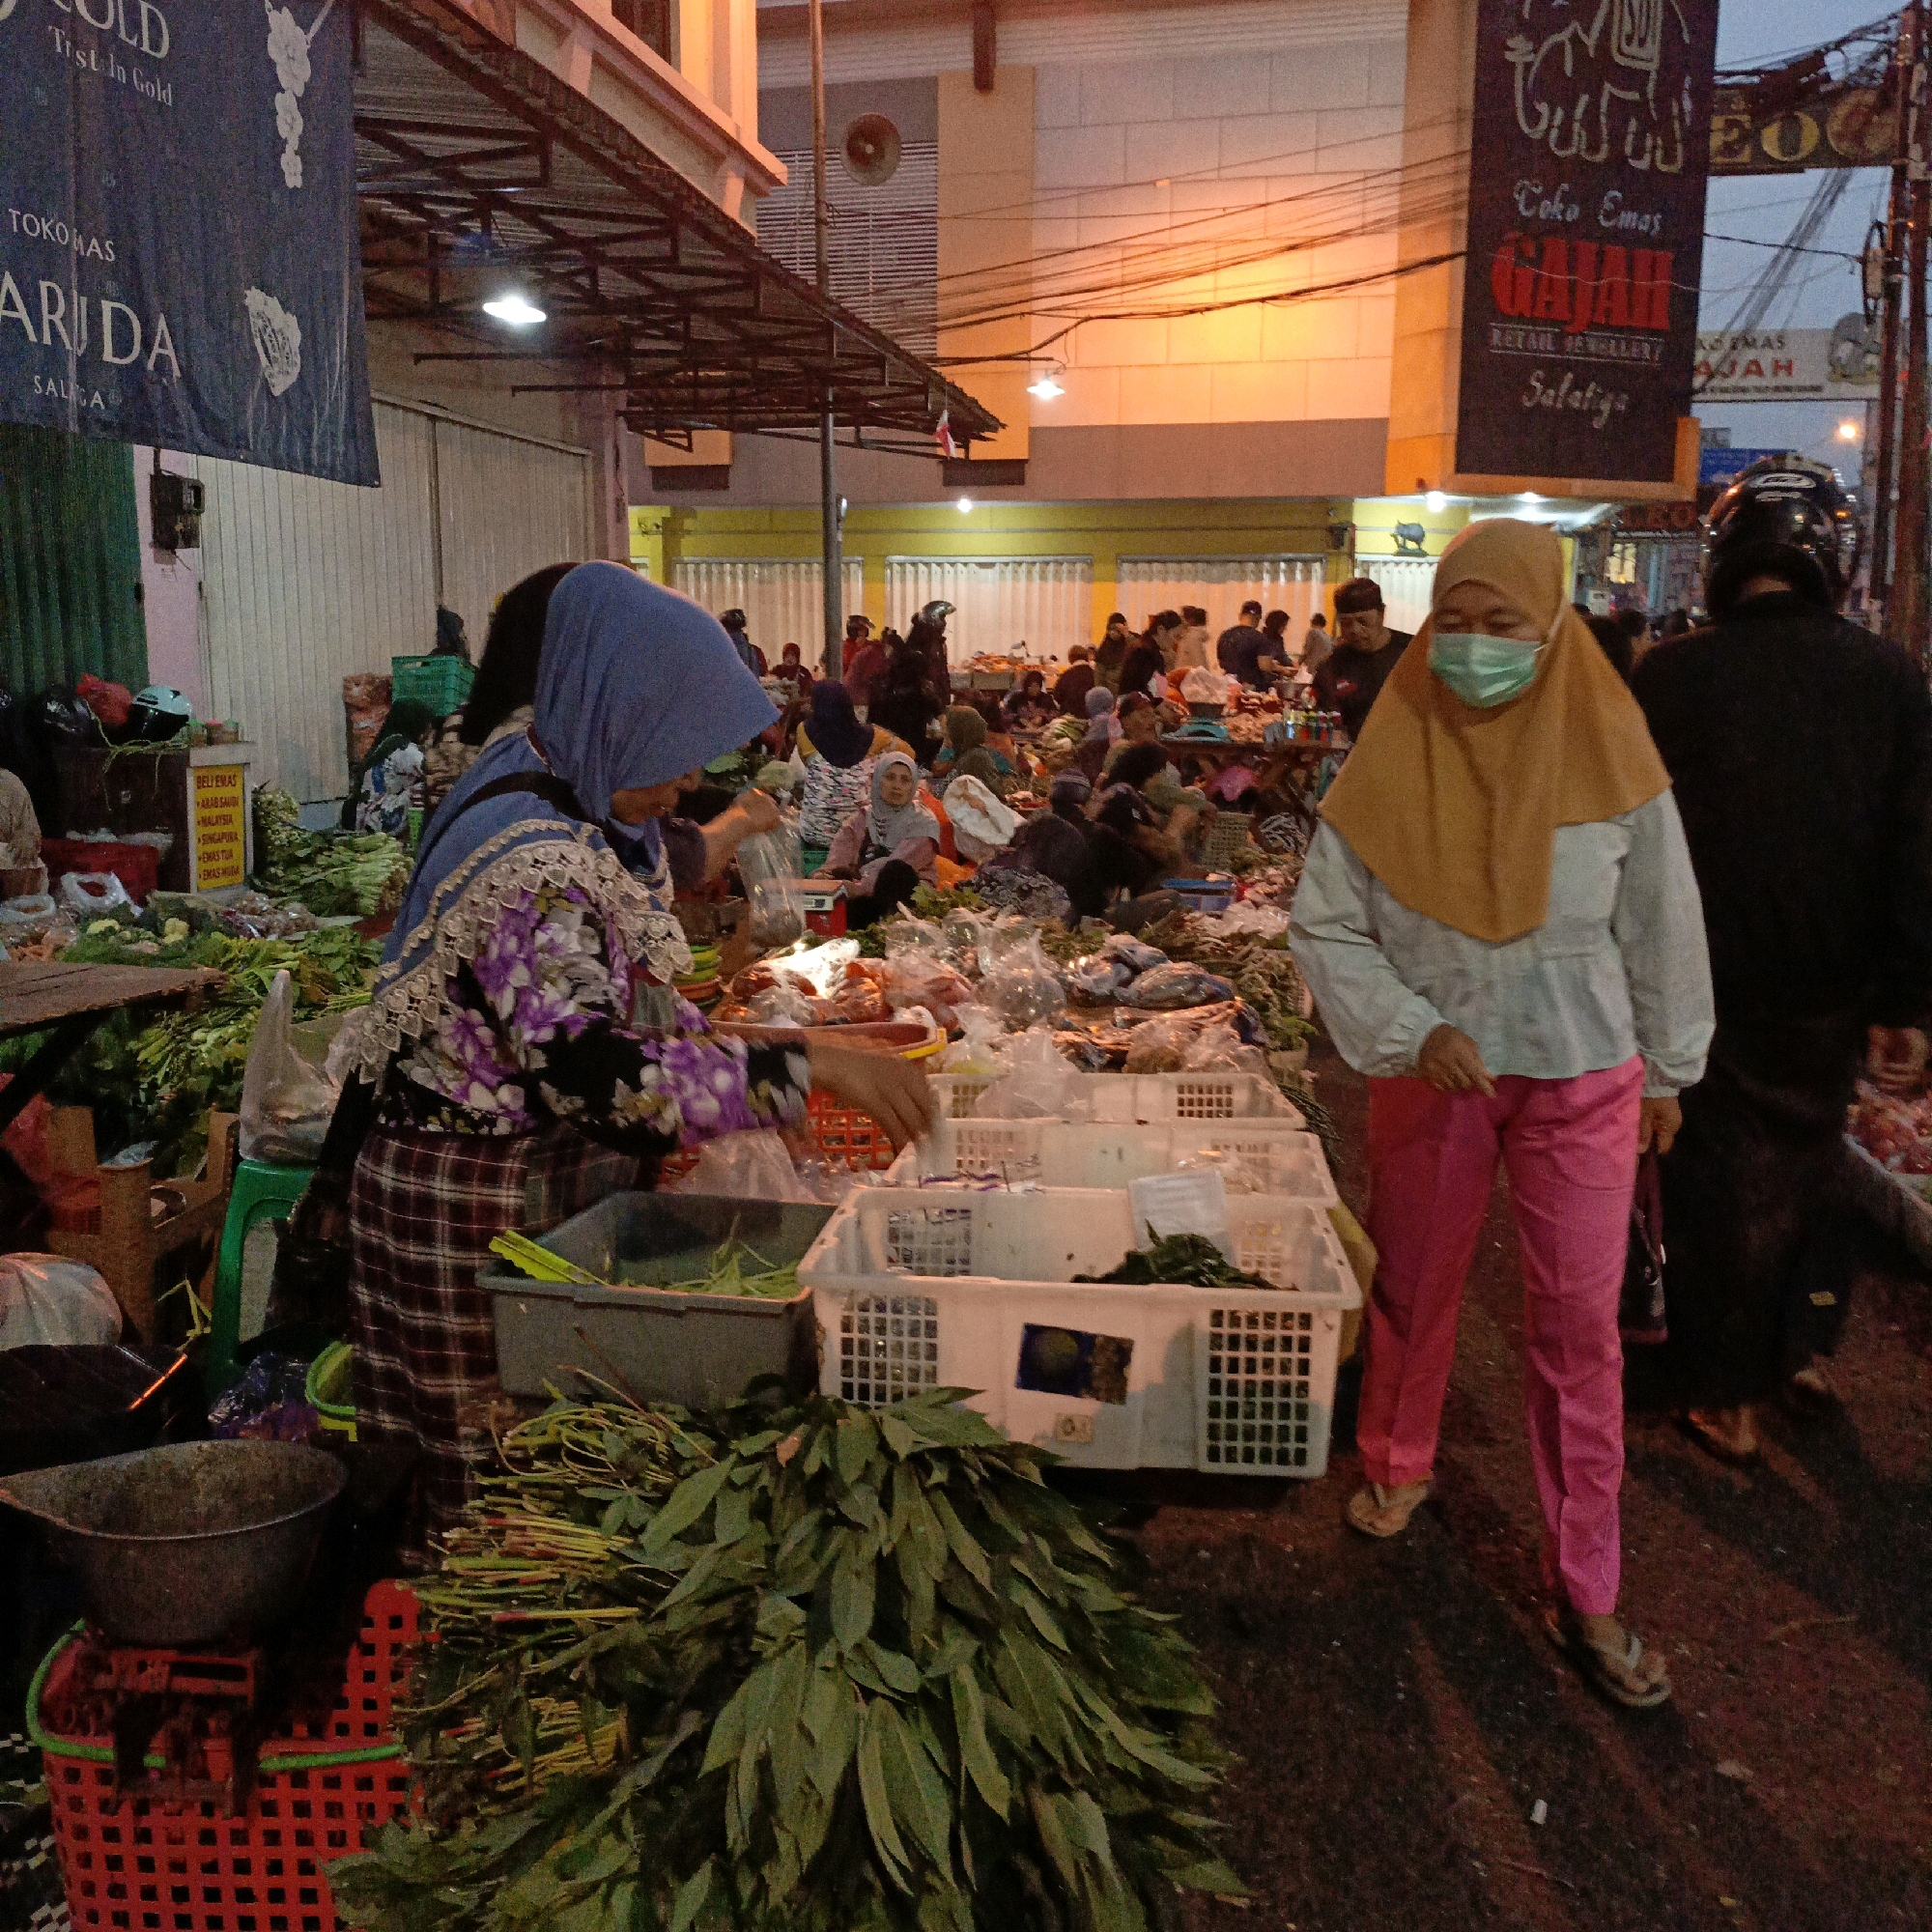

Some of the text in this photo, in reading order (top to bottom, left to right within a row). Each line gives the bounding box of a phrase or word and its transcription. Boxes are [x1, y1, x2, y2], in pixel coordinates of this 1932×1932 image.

[109, 52, 127, 84] In
[132, 67, 172, 106] Gold
[9, 208, 70, 246] TOKO
[1513, 180, 1662, 237] Toko Emas
[1491, 234, 1677, 334] GAJAH
[1491, 327, 1555, 352] RETAIL
[1521, 369, 1630, 429] Salatiga
[196, 774, 237, 789] BELI EMAS
[201, 797, 219, 810] ARAB
[201, 813, 234, 827] MALAYSIA
